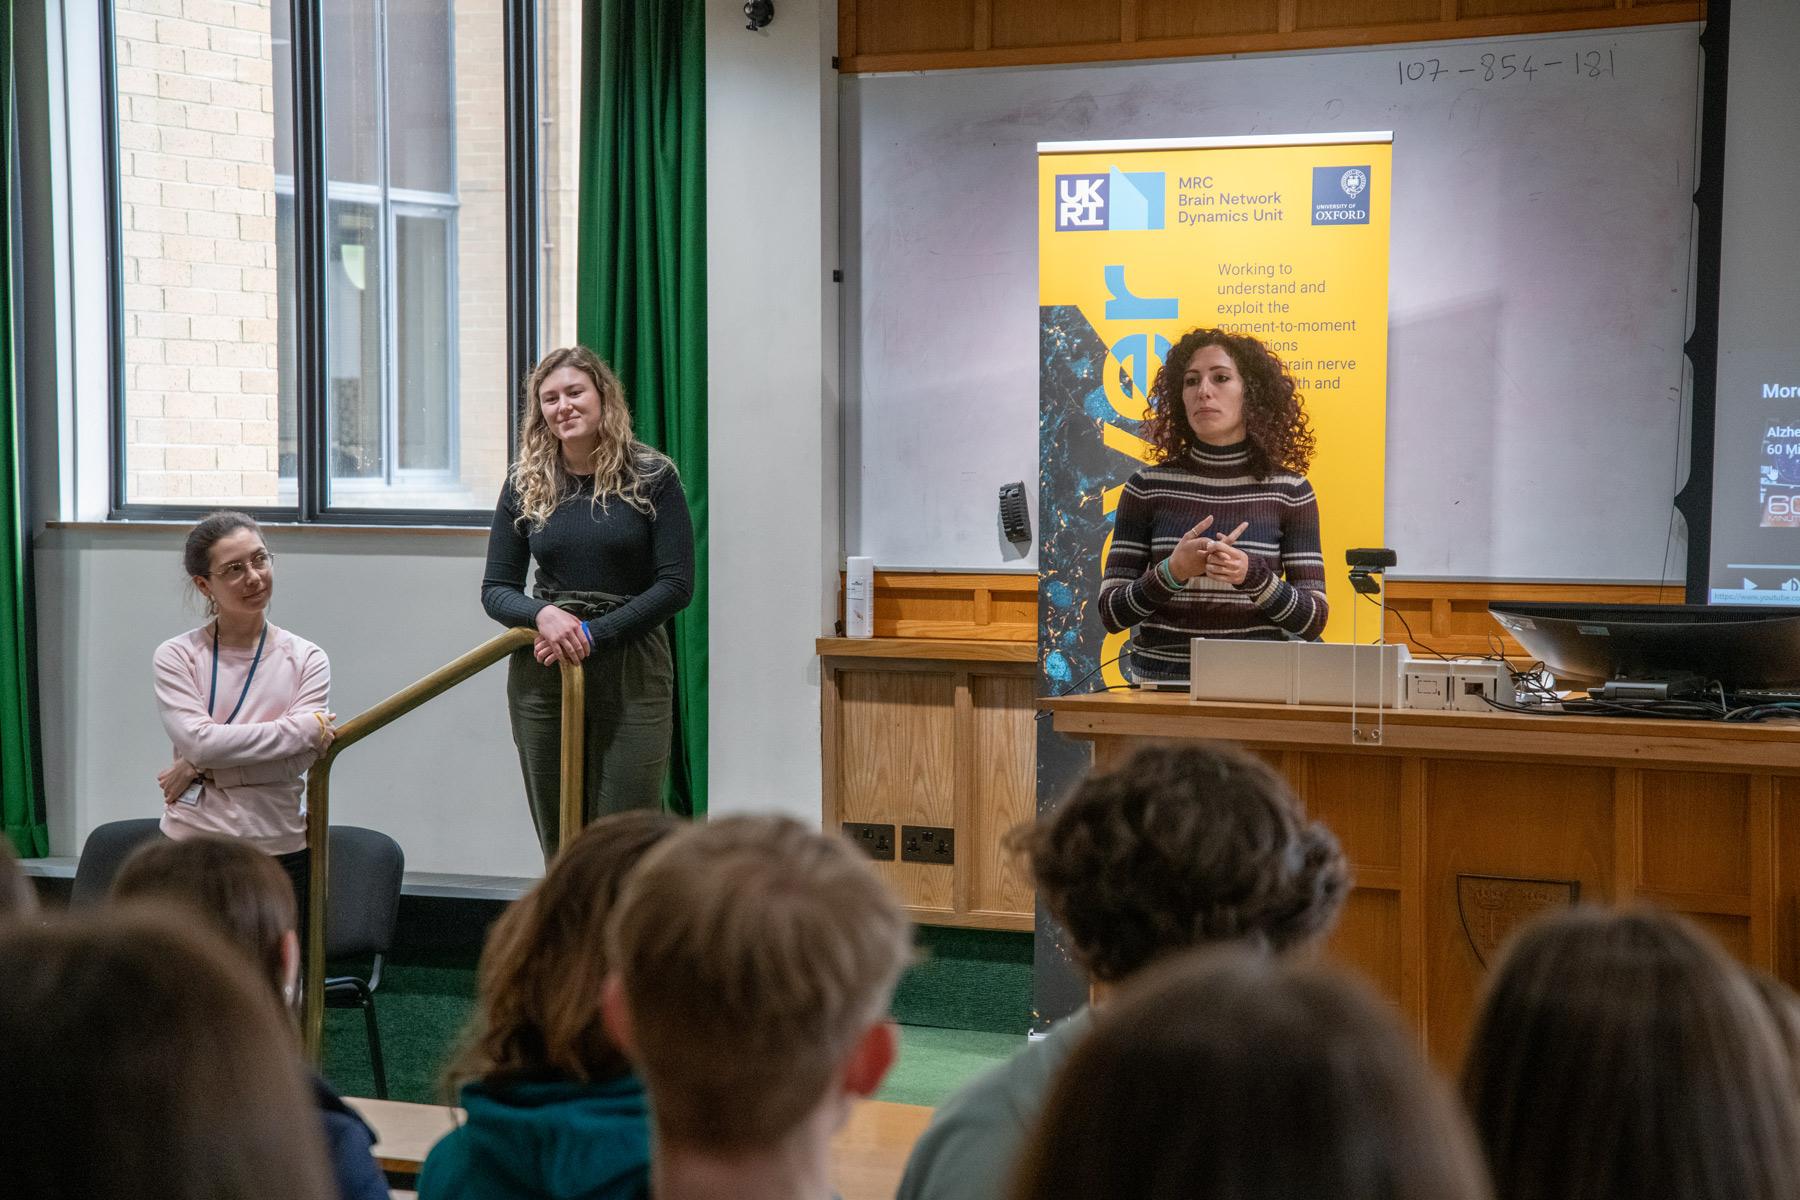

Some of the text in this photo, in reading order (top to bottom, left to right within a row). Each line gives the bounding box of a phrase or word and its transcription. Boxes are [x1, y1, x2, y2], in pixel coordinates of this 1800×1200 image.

[1178, 176, 1214, 189] MRC
[1061, 179, 1104, 207] UK
[1178, 192, 1282, 206] Brain Network
[1178, 208, 1284, 226] Dynamics Unit
[1315, 210, 1366, 220] OXFORD
[1218, 263, 1293, 278] Working to
[1217, 280, 1326, 295] understand and
[1217, 300, 1290, 317] exploit the
[1217, 320, 1356, 333] moment-to-moment
[1317, 360, 1356, 370] nerve
[1315, 376, 1341, 390] and
[1767, 444, 1783, 455] 60
